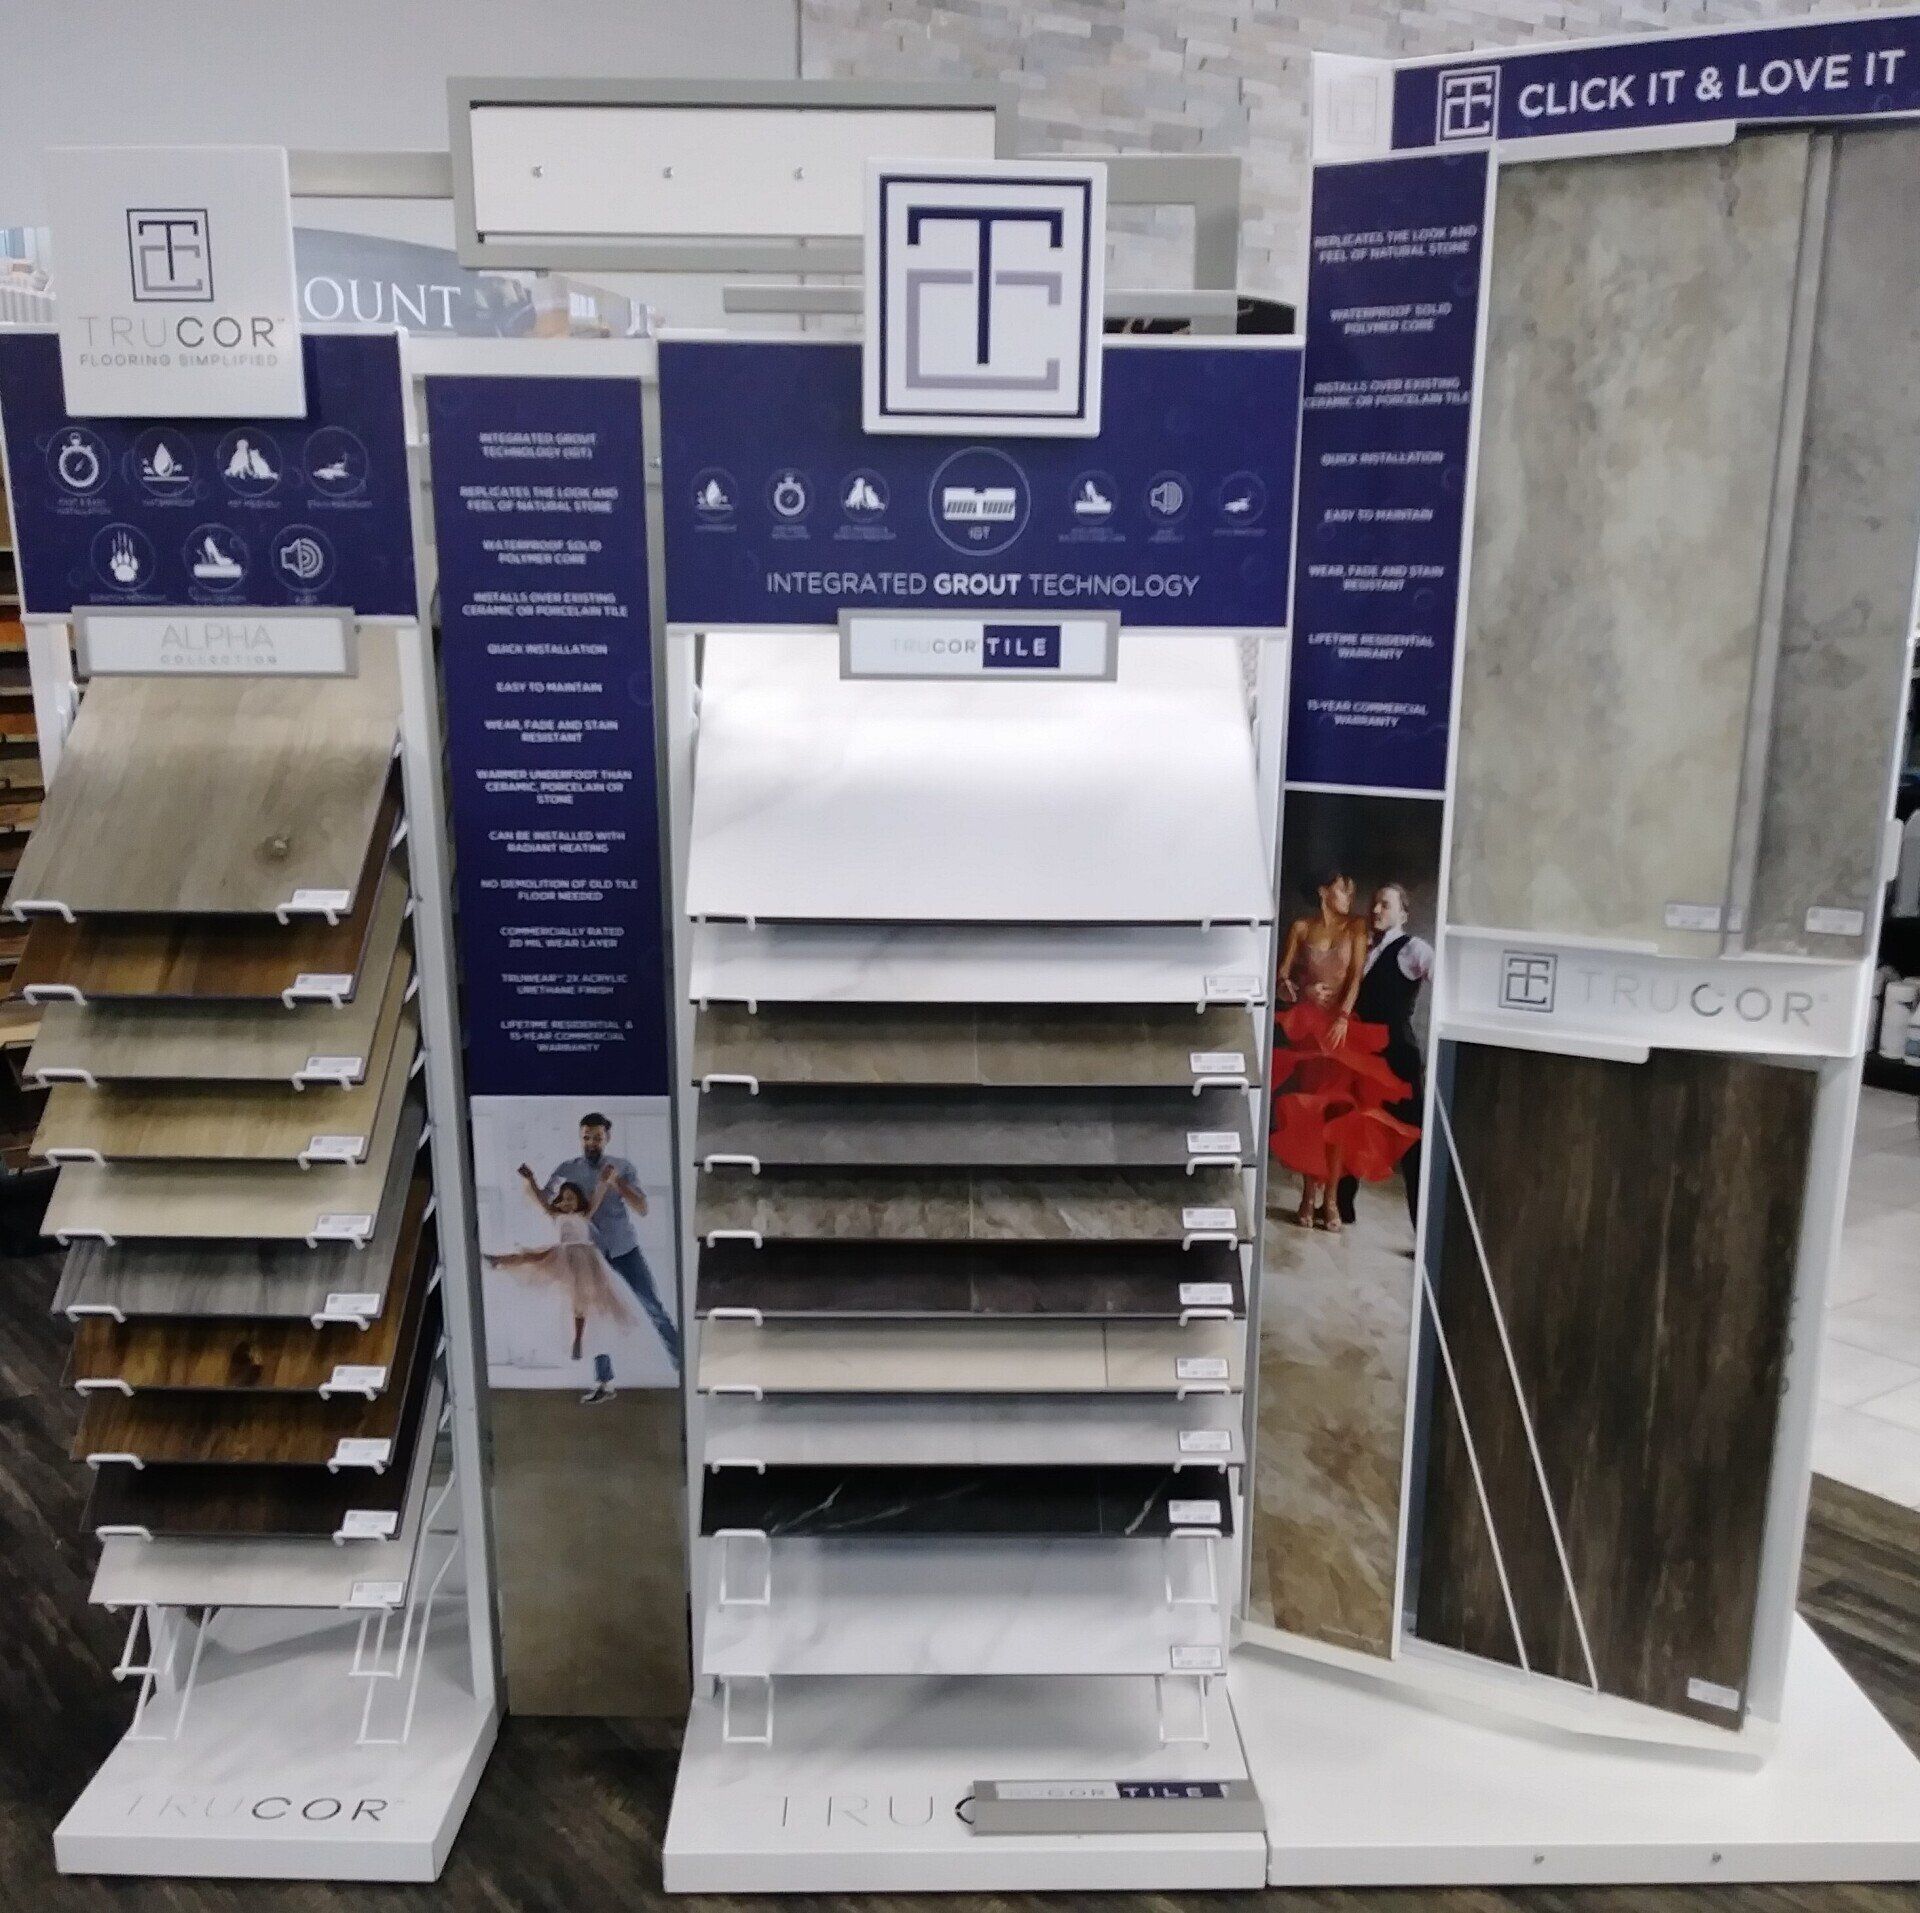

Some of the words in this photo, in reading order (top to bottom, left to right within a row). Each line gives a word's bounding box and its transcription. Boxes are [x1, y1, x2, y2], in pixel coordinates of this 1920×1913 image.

[1517, 71, 1637, 119] CLICK
[1647, 69, 1687, 105] IT
[1696, 65, 1726, 101] &
[1736, 51, 1852, 99] LOVE
[1864, 48, 1906, 86] IT
[303, 275, 462, 328] OUNT
[79, 353, 172, 368] FLOORING
[178, 353, 279, 368] SIMPLIFIED
[766, 571, 927, 596] INTEGRATED
[932, 573, 1022, 596] GROUT
[1029, 573, 1200, 599] TECHNOLOGY
[160, 623, 275, 650] ALPHA
[985, 637, 1048, 658] TILE
[160, 653, 278, 666] COLLECTION
[536, 793, 574, 805] STONE
[1121, 1786, 1205, 1799] TILE
